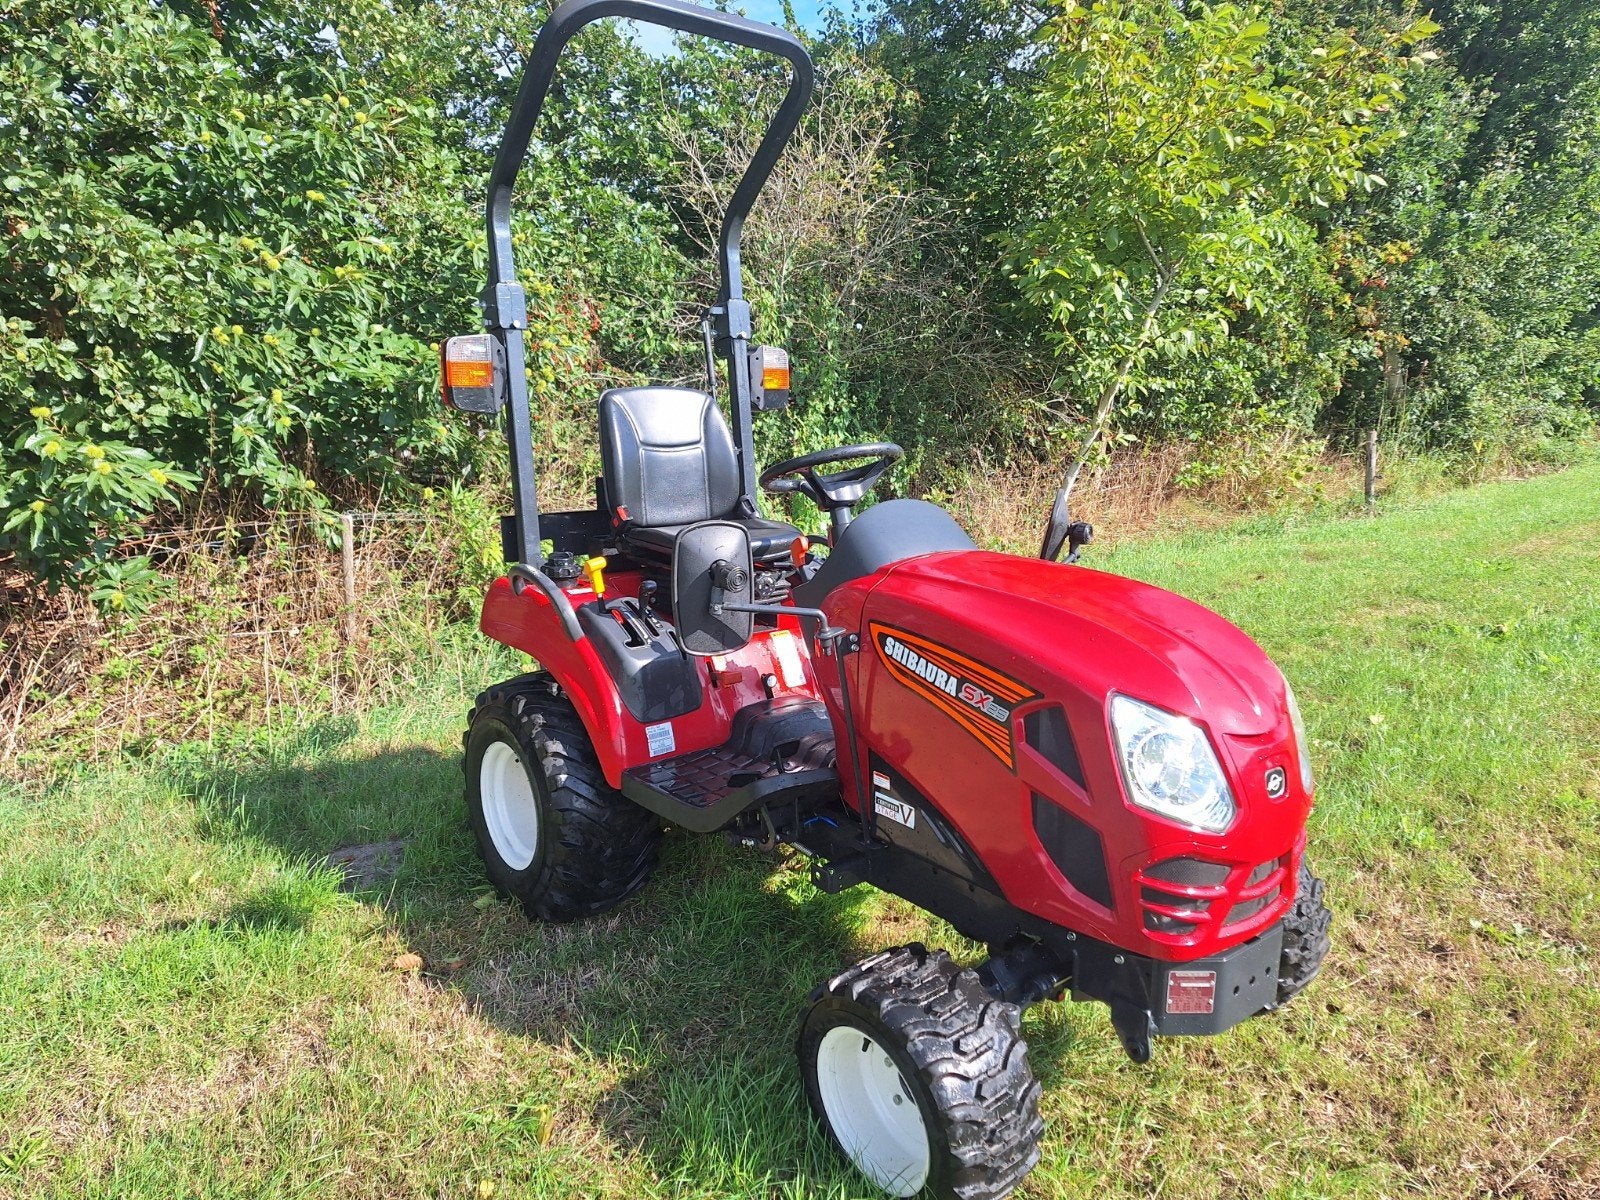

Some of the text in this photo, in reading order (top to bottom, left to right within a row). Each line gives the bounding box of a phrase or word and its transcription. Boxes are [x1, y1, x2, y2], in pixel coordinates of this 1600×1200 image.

[884, 637, 958, 697] SHIBAURA
[876, 803, 914, 824] STAGE V
